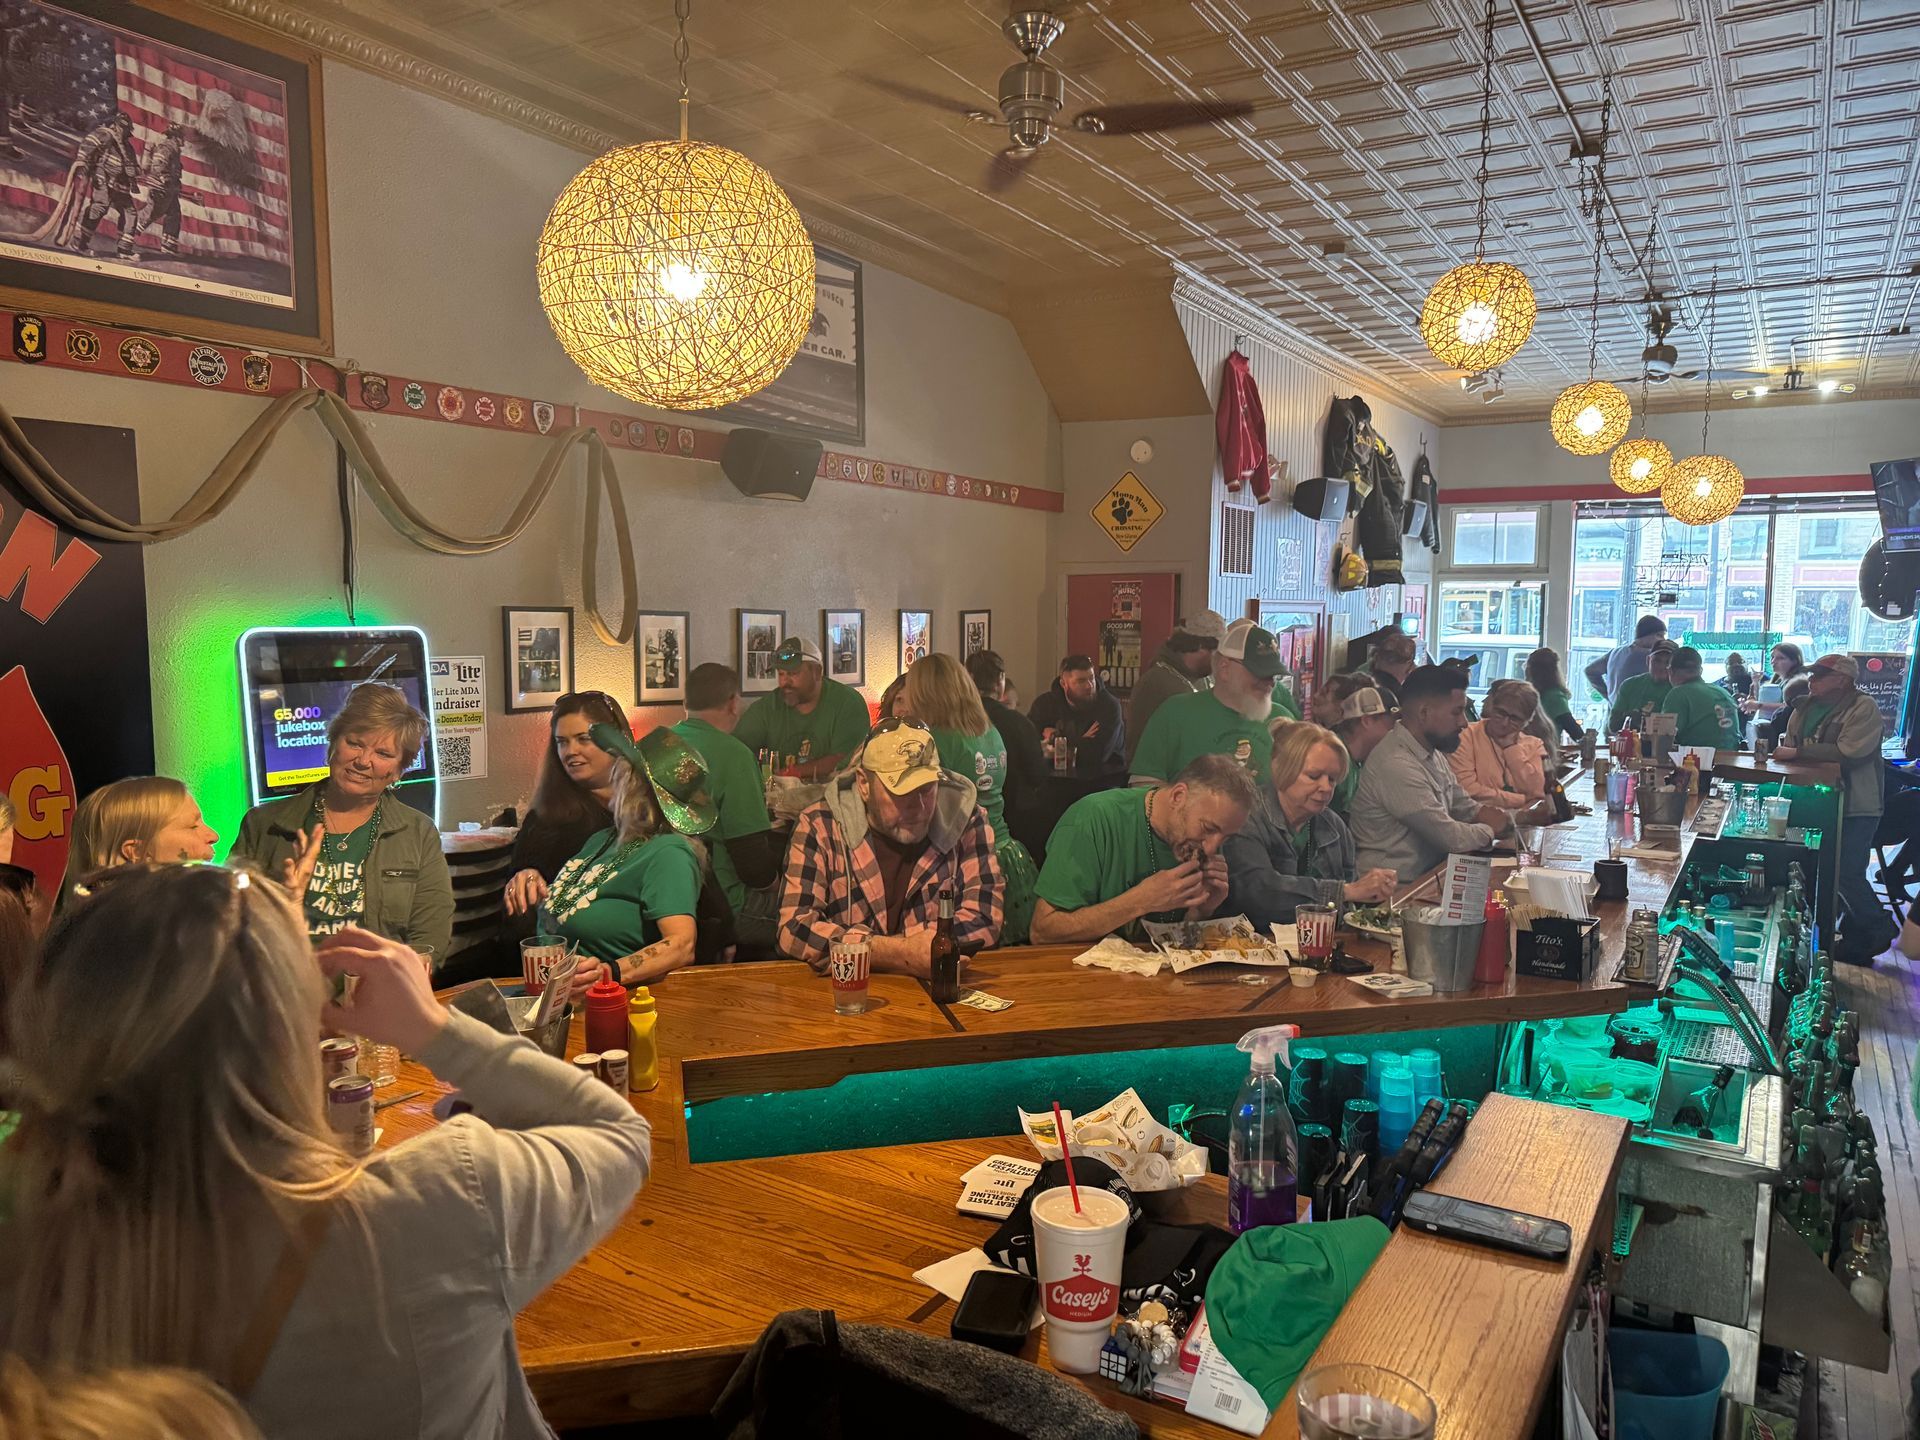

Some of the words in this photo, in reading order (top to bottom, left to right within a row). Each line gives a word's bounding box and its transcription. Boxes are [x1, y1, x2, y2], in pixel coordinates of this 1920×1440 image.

[133, 271, 163, 283] UNITY
[229, 289, 274, 304] STRENGTH
[821, 346, 846, 360] CAR.
[456, 665, 480, 683] Lite
[445, 687, 459, 696] Lite
[461, 686, 480, 695] MDA
[274, 706, 321, 721] 65,000
[441, 715, 463, 723] Donate
[463, 713, 482, 723] Today
[275, 720, 326, 736] jukebox
[8, 765, 71, 841] G
[1535, 934, 1563, 945] Tito's
[987, 1162, 1006, 1172] LESS
[992, 1159, 1018, 1169] GREAT
[994, 1180, 1016, 1188] Lite
[967, 1196, 994, 1206] TASTE
[970, 1191, 1006, 1201] FILLING
[1052, 1285, 1110, 1312] Casey's
